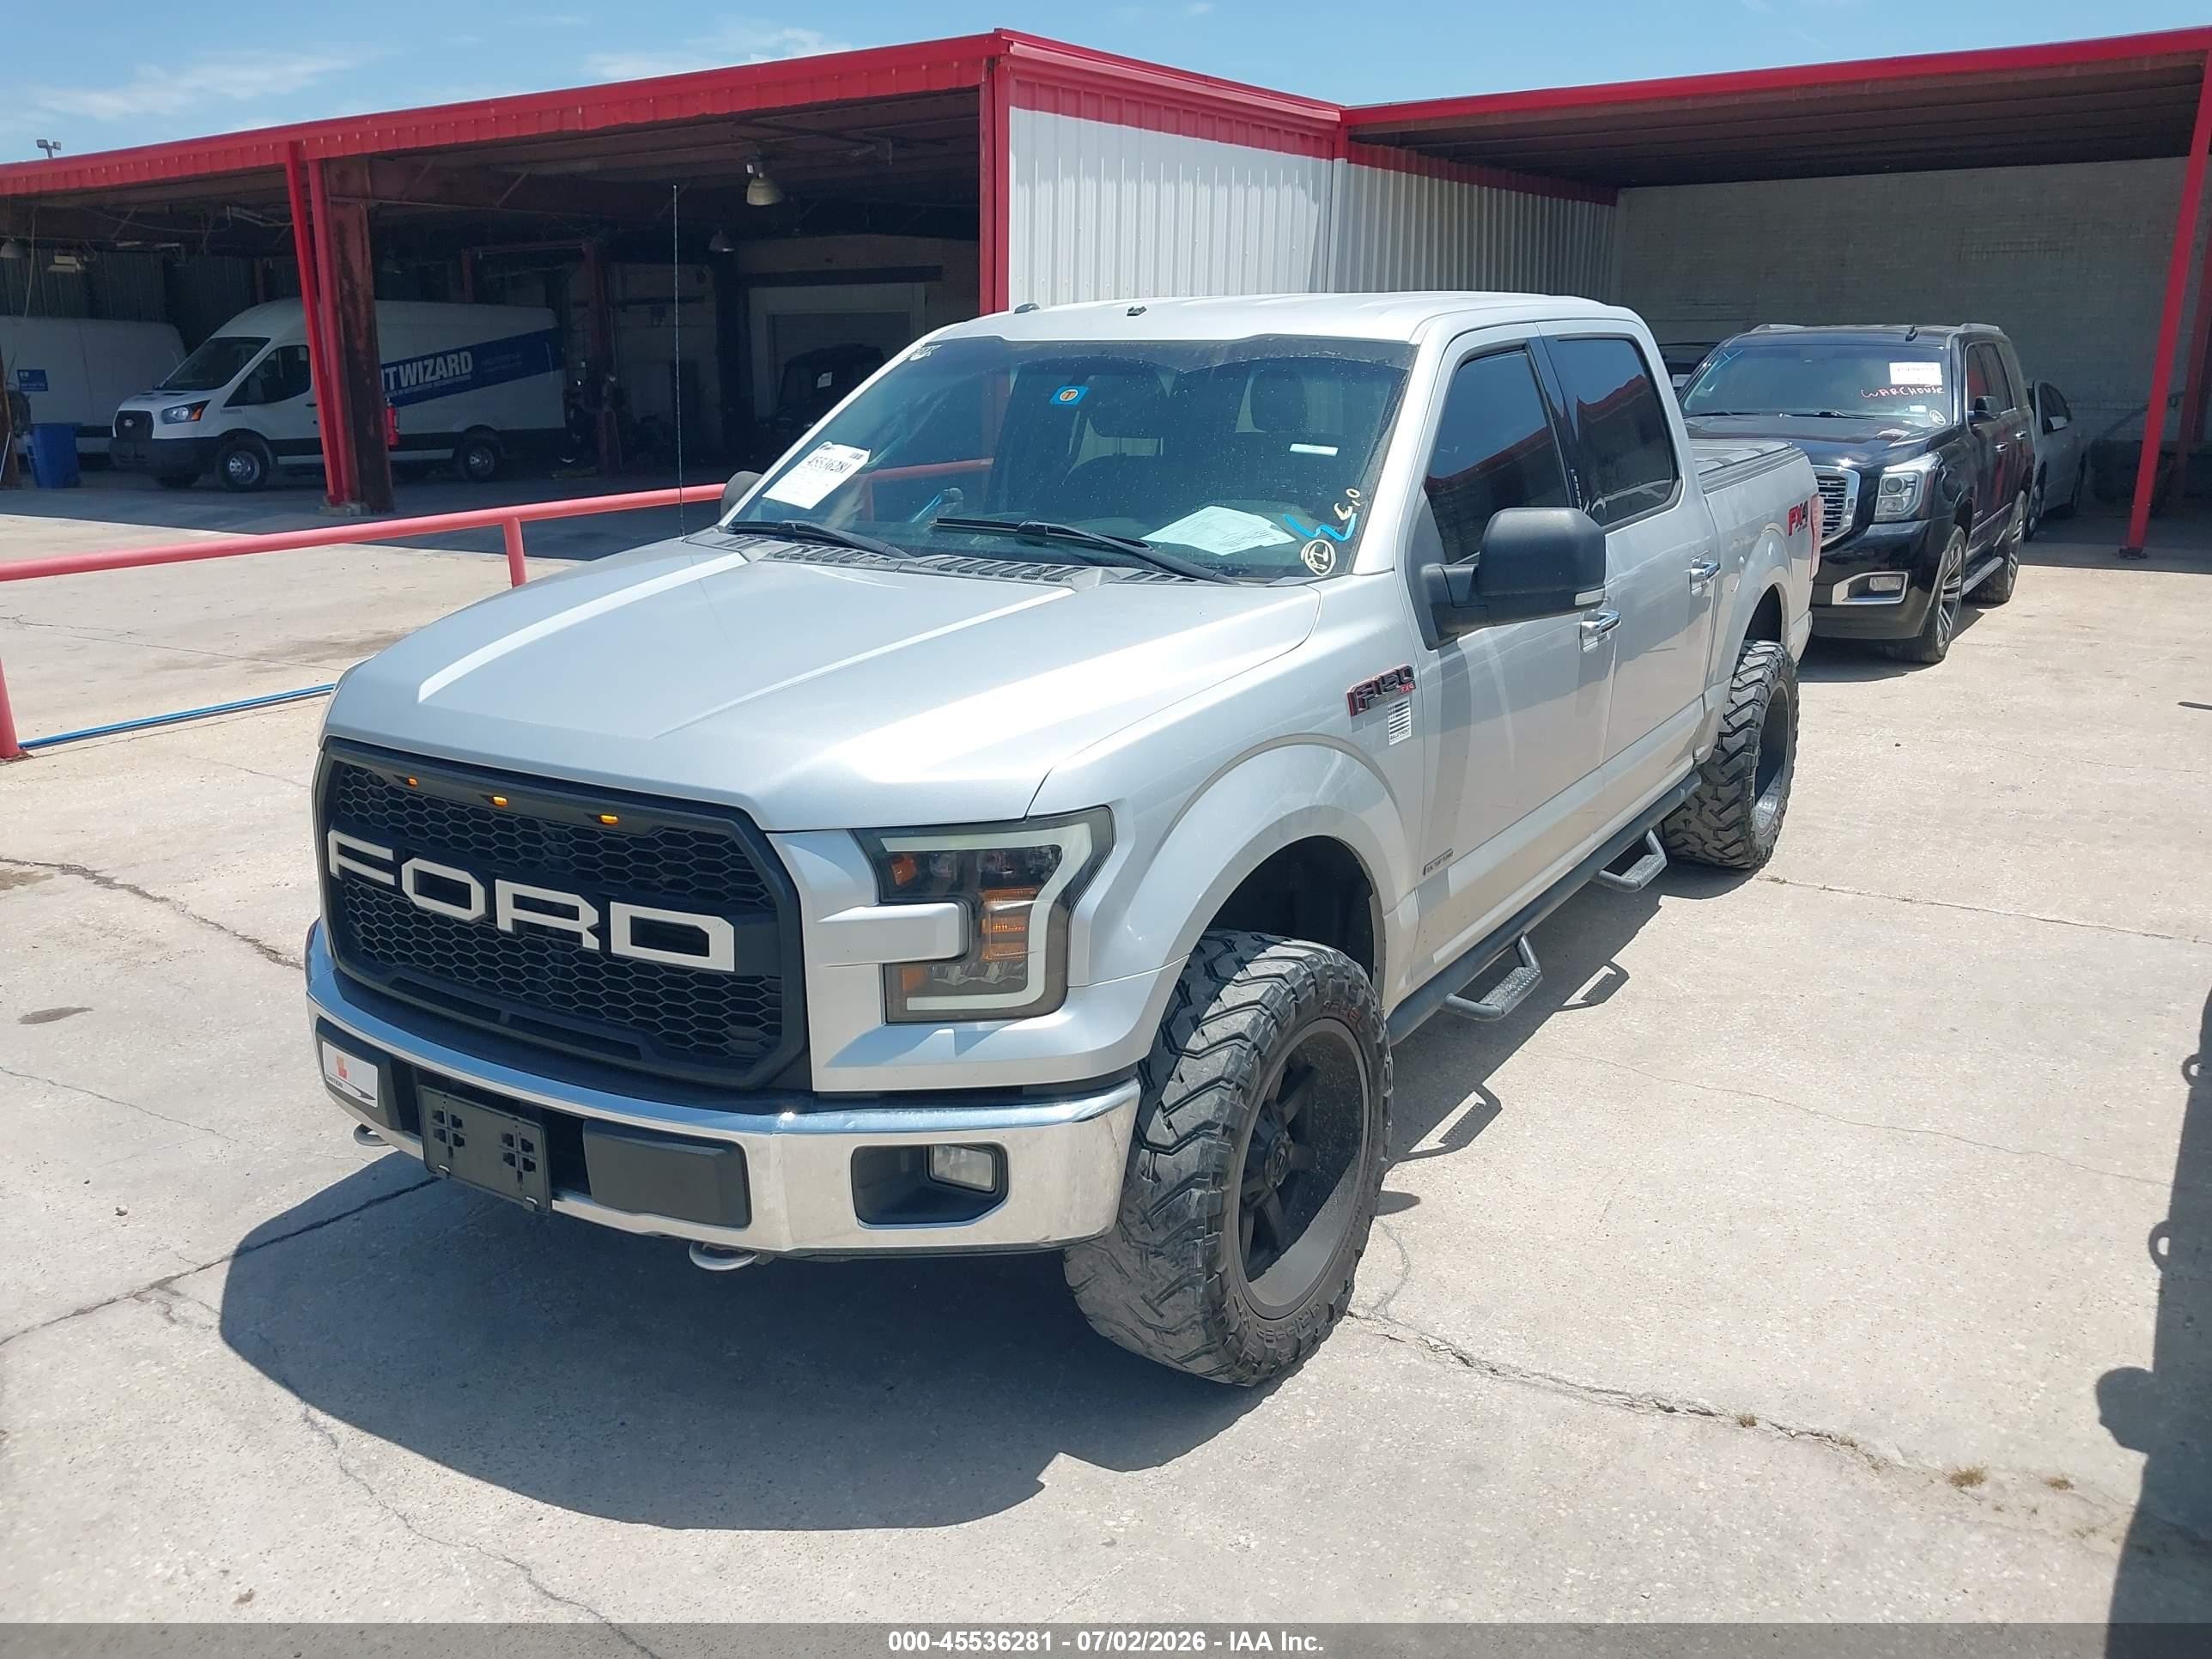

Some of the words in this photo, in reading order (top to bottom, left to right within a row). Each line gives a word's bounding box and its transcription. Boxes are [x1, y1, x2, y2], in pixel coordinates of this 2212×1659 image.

[398, 350, 473, 387] WIZARD
[1788, 500, 1808, 537] FX4
[327, 829, 735, 972] FORD
